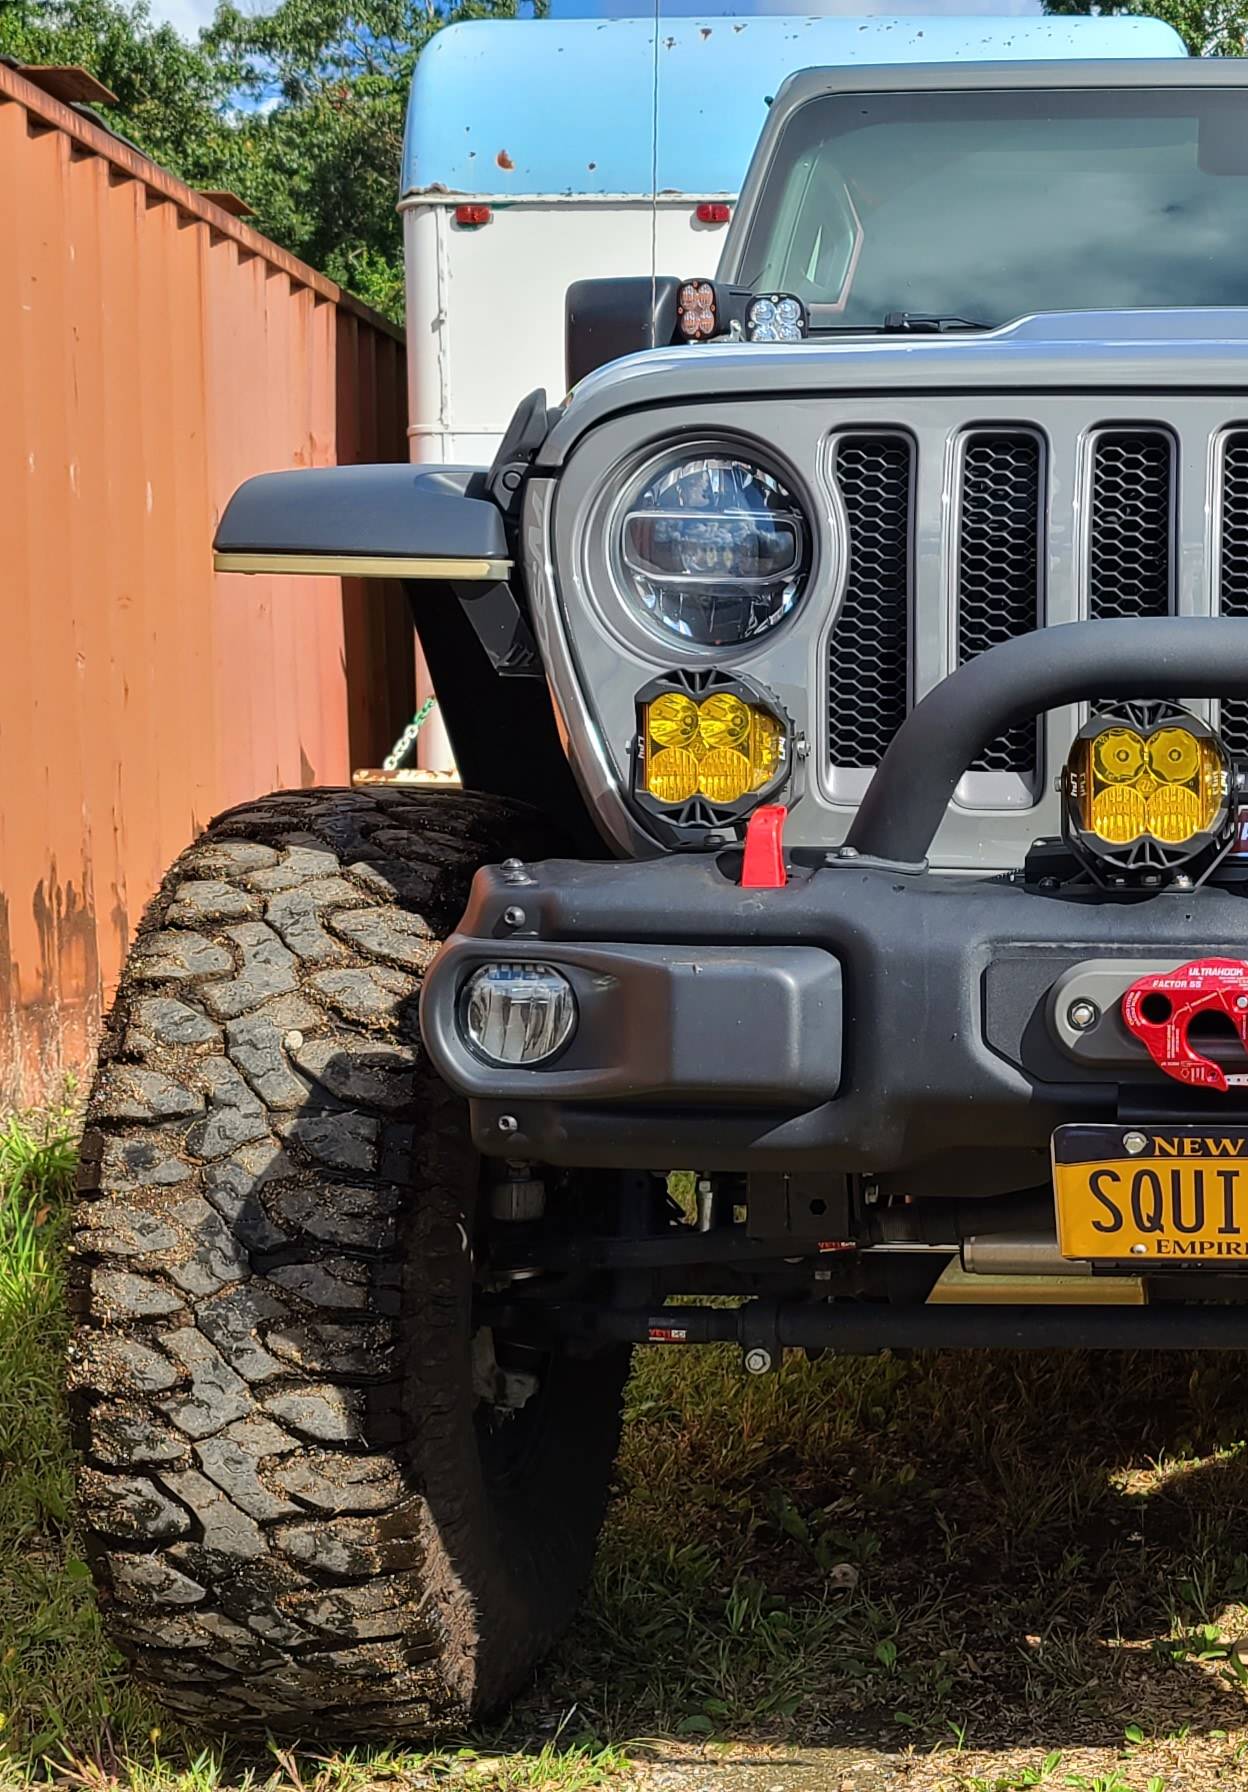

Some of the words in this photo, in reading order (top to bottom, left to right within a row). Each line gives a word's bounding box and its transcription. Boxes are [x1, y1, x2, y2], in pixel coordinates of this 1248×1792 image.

[1189, 967, 1244, 976] ULTRAHOOK
[1152, 980, 1187, 988] FACTOR
[1153, 1137, 1244, 1156] NEW
